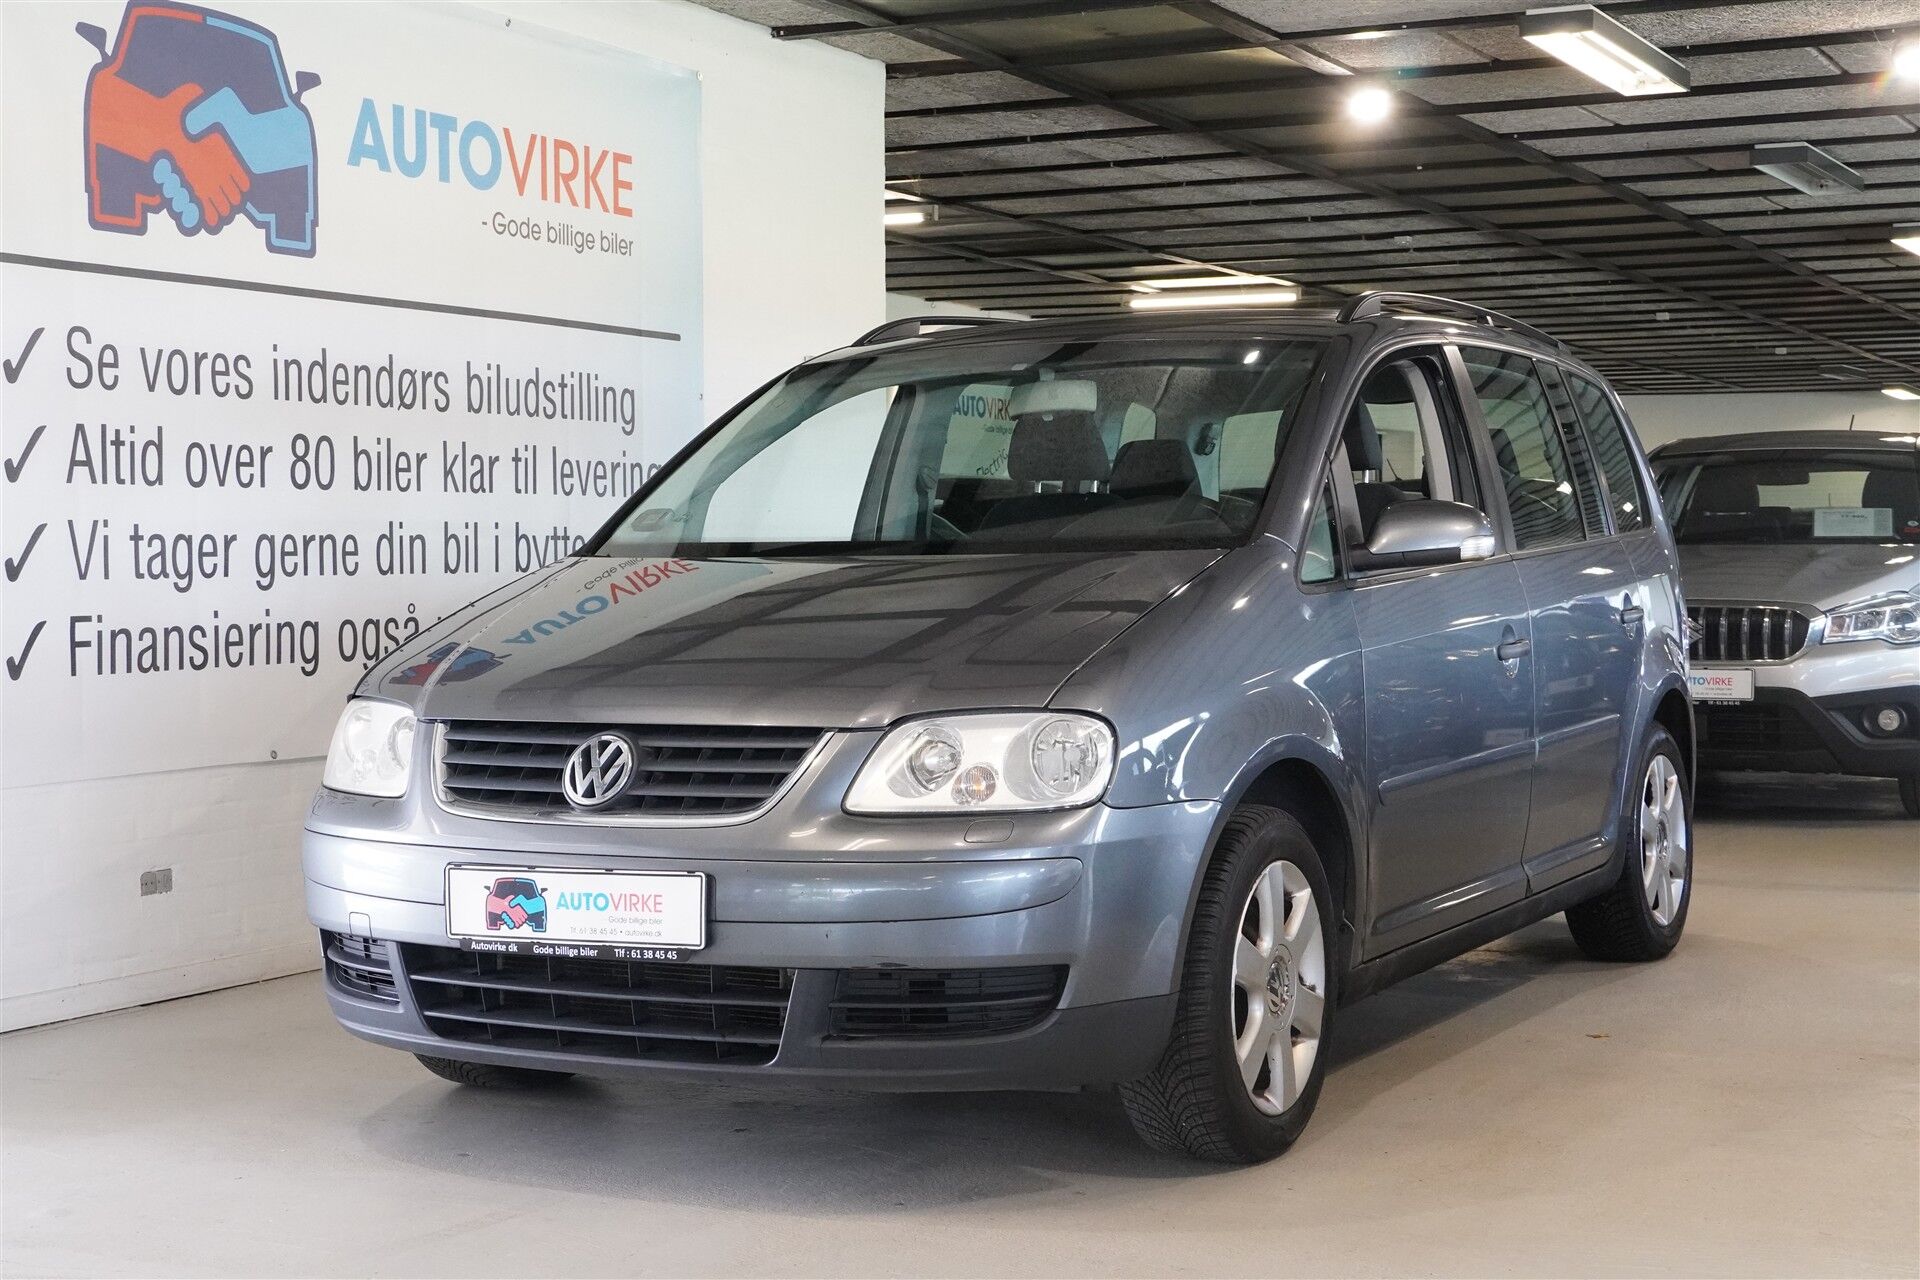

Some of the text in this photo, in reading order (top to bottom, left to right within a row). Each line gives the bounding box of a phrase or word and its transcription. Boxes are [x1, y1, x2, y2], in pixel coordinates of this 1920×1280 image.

[347, 98, 634, 217] AUTOVIRKE
[492, 212, 542, 240] Gode
[547, 221, 596, 255] billige
[601, 230, 634, 257] biler
[67, 326, 636, 437] Se vores indendørs biludstilling
[953, 395, 1012, 421] AUTOVIRK
[66, 423, 164, 487] Altid
[186, 441, 274, 489] over
[290, 433, 336, 491] 80
[353, 436, 428, 492] biler
[442, 440, 500, 494] klar
[511, 444, 538, 496] til
[67, 519, 110, 581] Vi
[130, 523, 238, 594] tager
[254, 533, 359, 592] gerne
[375, 520, 427, 576] din
[443, 520, 479, 575] bil
[494, 521, 500, 574] i
[70, 608, 320, 678] Finansiering
[556, 892, 663, 914] AUTOVIRKE
[471, 941, 506, 952] Autovirke
[533, 945, 554, 955] Gode
[555, 945, 579, 957] billige
[580, 946, 599, 957] biler
[631, 949, 641, 959] 61
[643, 949, 653, 959] 38
[655, 950, 666, 960] 45
[667, 950, 678, 960] 45
